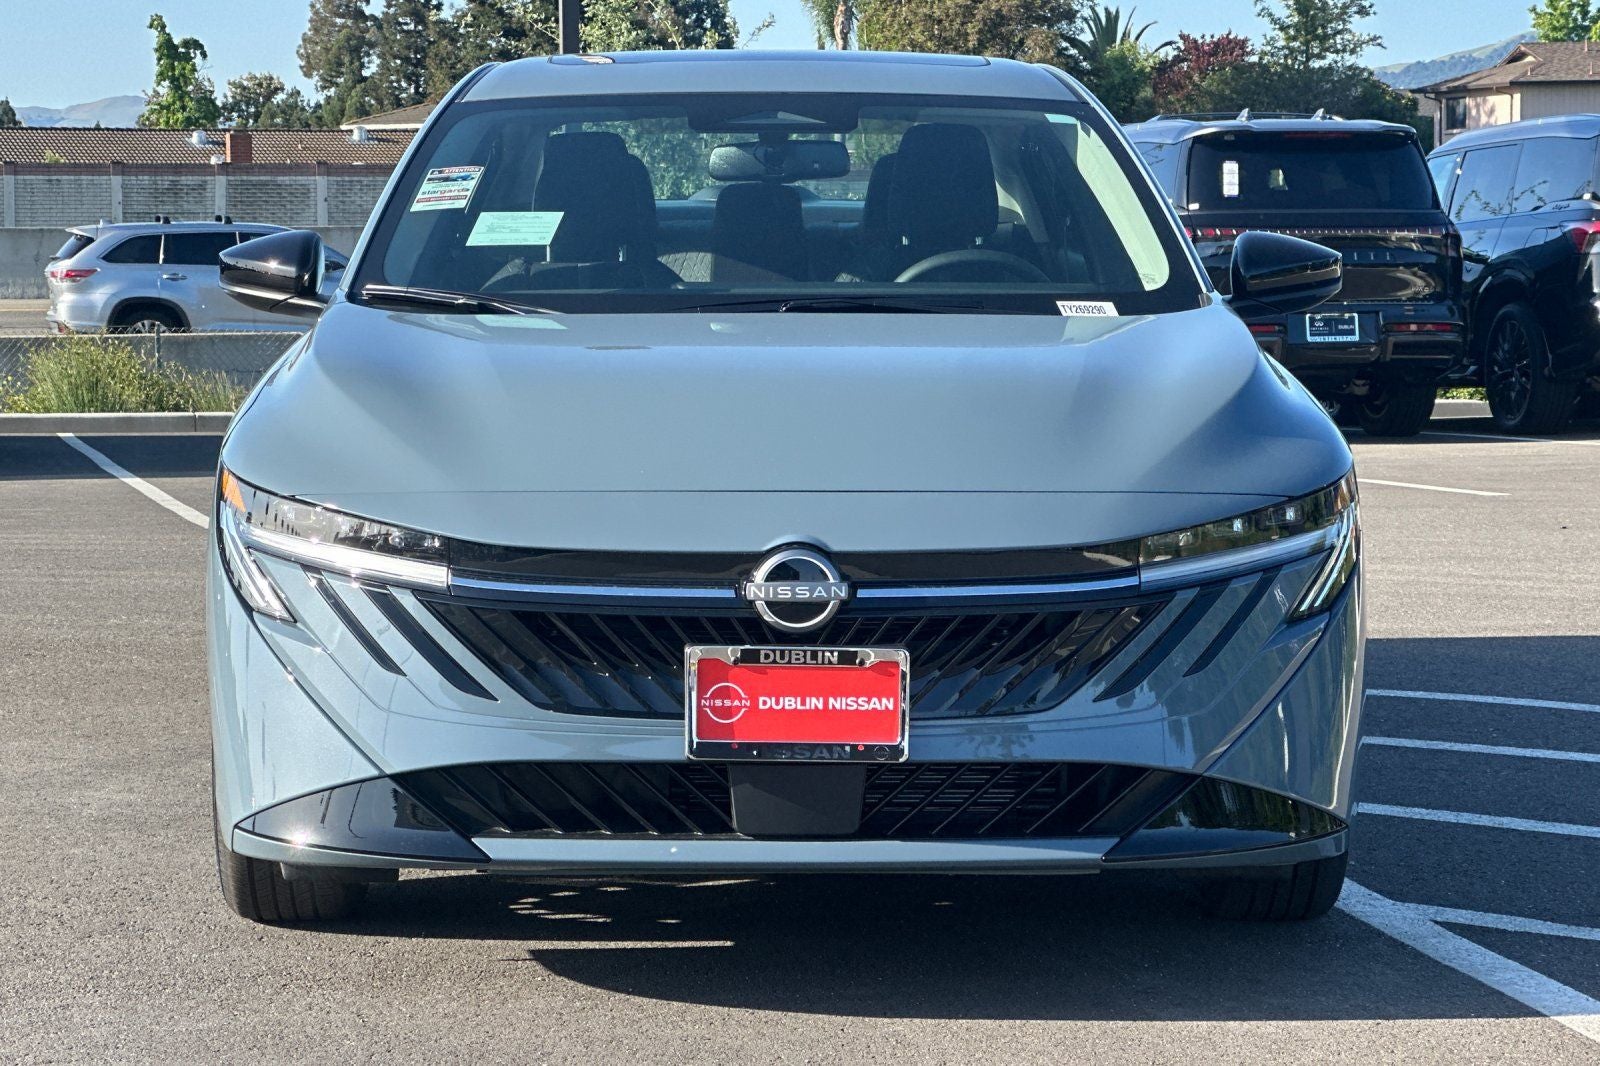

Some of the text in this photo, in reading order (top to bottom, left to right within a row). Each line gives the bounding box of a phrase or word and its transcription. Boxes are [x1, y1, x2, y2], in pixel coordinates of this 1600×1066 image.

[1060, 305, 1107, 315] TY269290
[750, 586, 847, 599] NISSAN
[759, 650, 838, 664] DUBLIN
[758, 697, 894, 711] DUBLIN NISSAN
